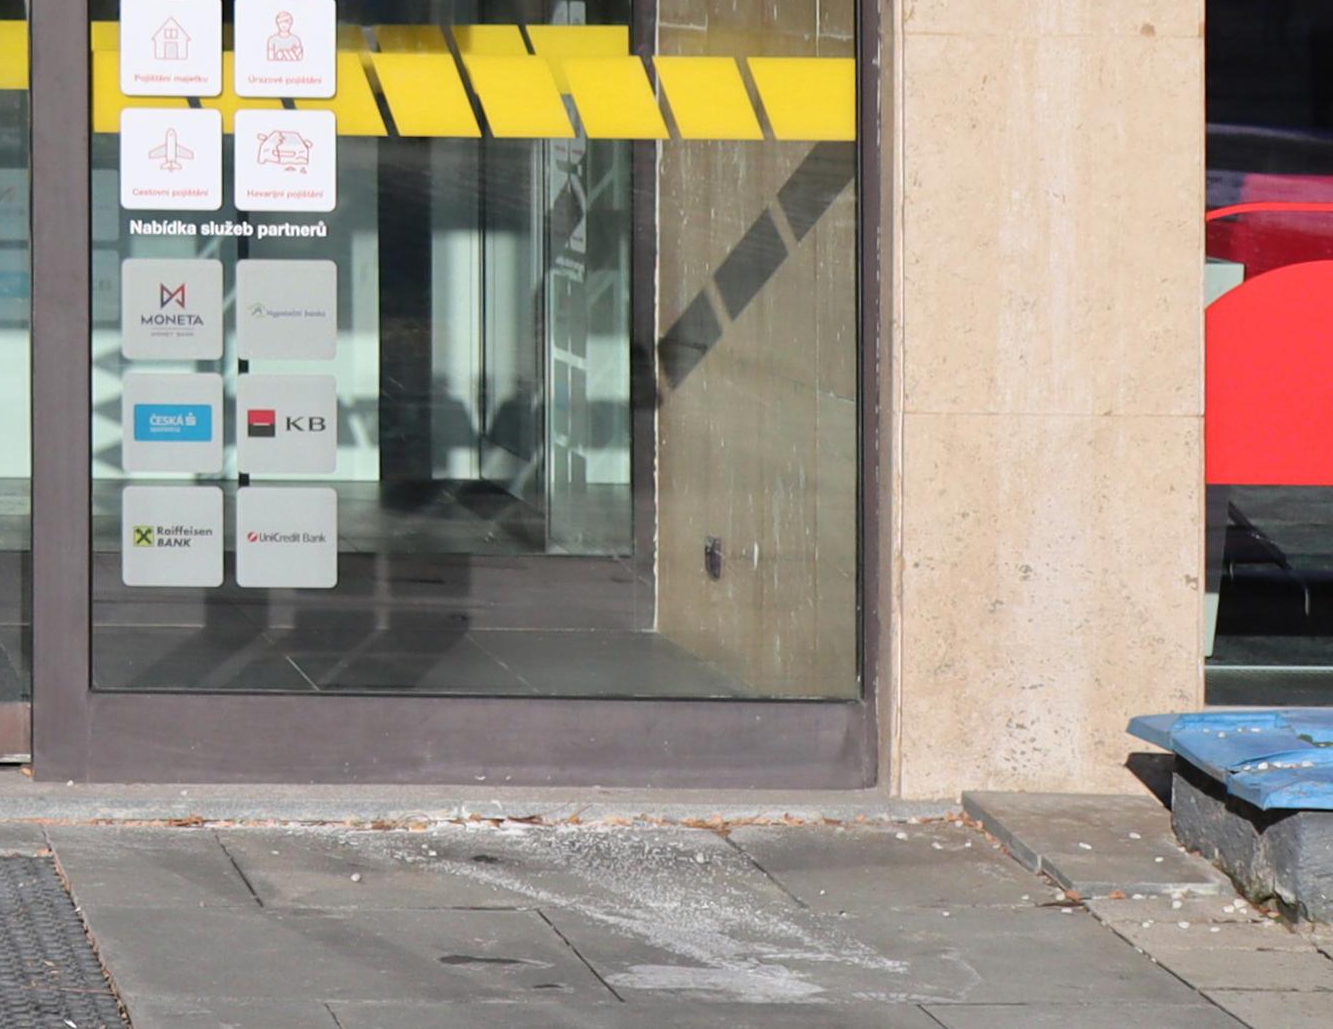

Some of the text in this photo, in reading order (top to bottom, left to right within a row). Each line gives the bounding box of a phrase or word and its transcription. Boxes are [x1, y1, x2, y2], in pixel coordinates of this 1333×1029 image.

[129, 219, 328, 239] Nabídka služeb partnerů
[140, 314, 204, 326] MONETA
[149, 412, 185, 426] ČESKÁ
[156, 525, 213, 537] Raiffeisen
[157, 538, 192, 547] BANK
[259, 532, 327, 544] UniCredit Bank
